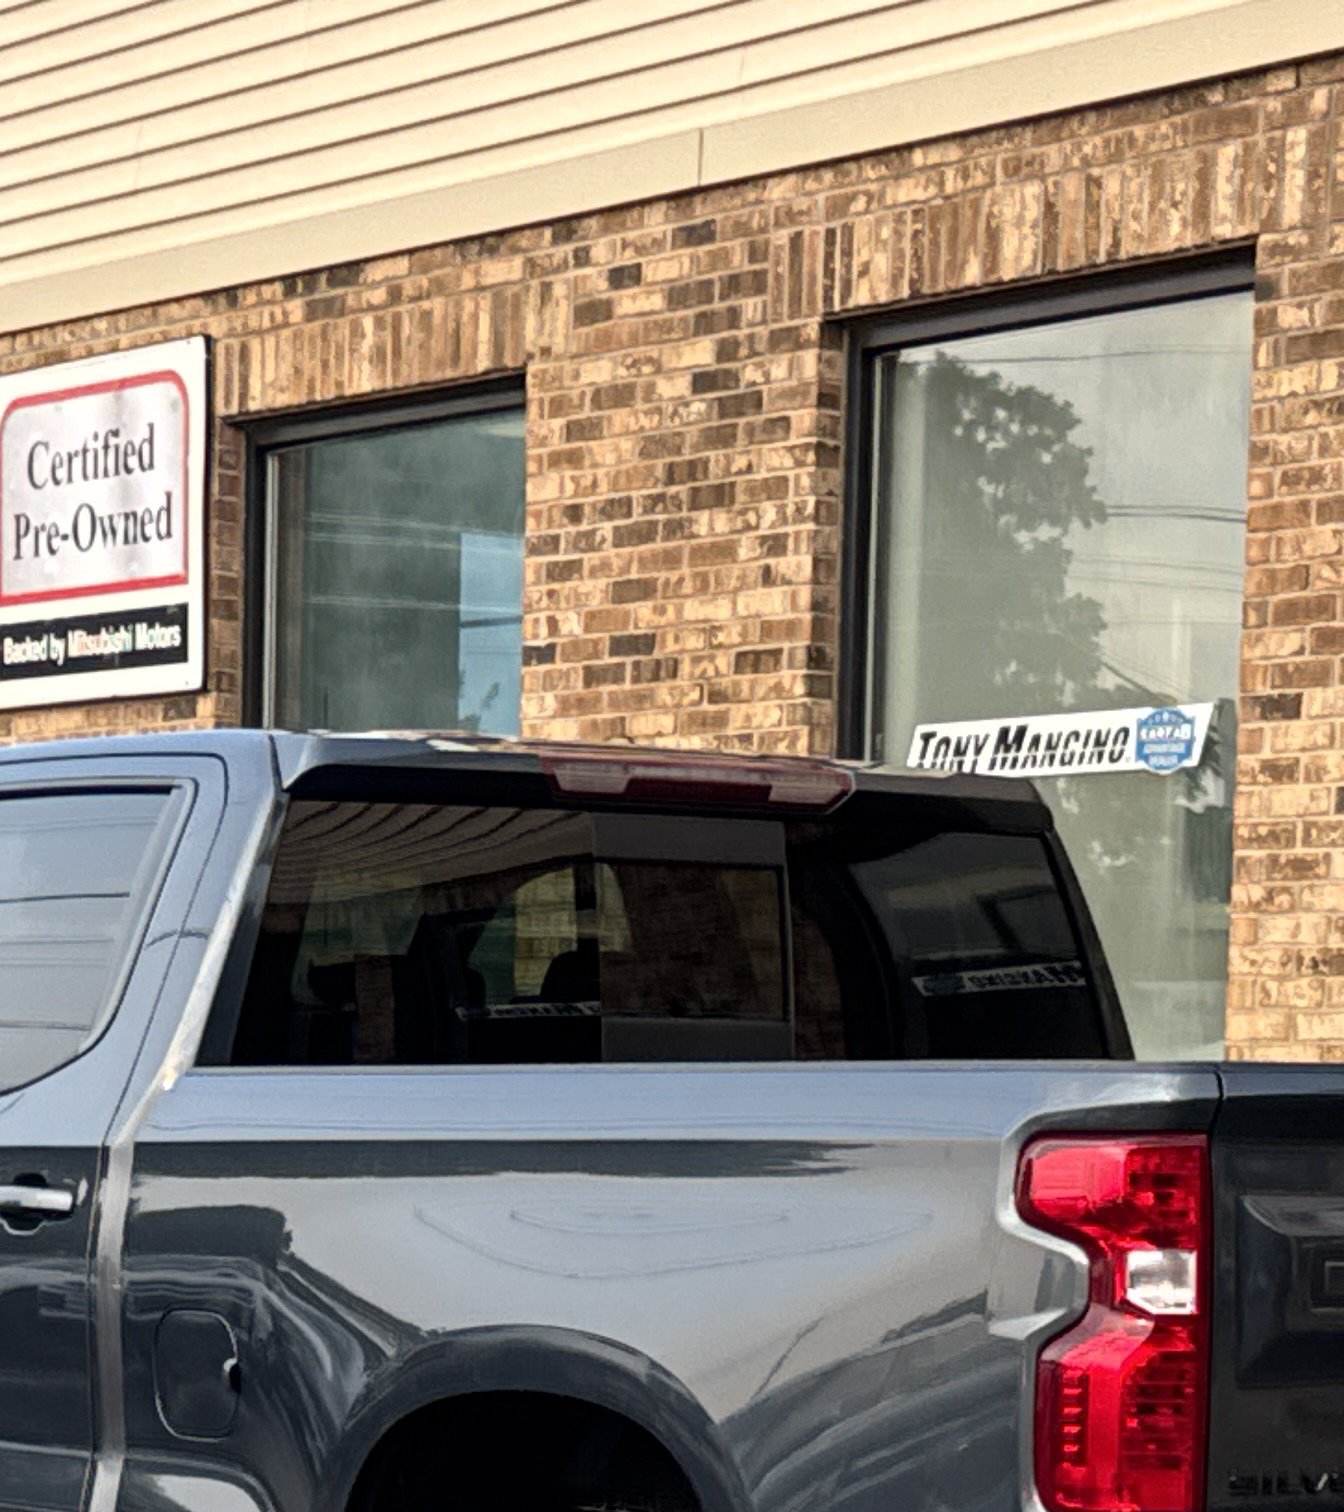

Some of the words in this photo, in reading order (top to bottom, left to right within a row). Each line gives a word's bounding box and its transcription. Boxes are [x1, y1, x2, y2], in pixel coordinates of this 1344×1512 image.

[27, 422, 155, 490] Certified
[12, 491, 173, 561] Pre-Owned
[2, 635, 48, 665] Backed
[48, 633, 66, 666] by
[67, 624, 133, 659] Mitsubishi
[134, 621, 182, 651] Motors
[987, 724, 1130, 772] MANGINO
